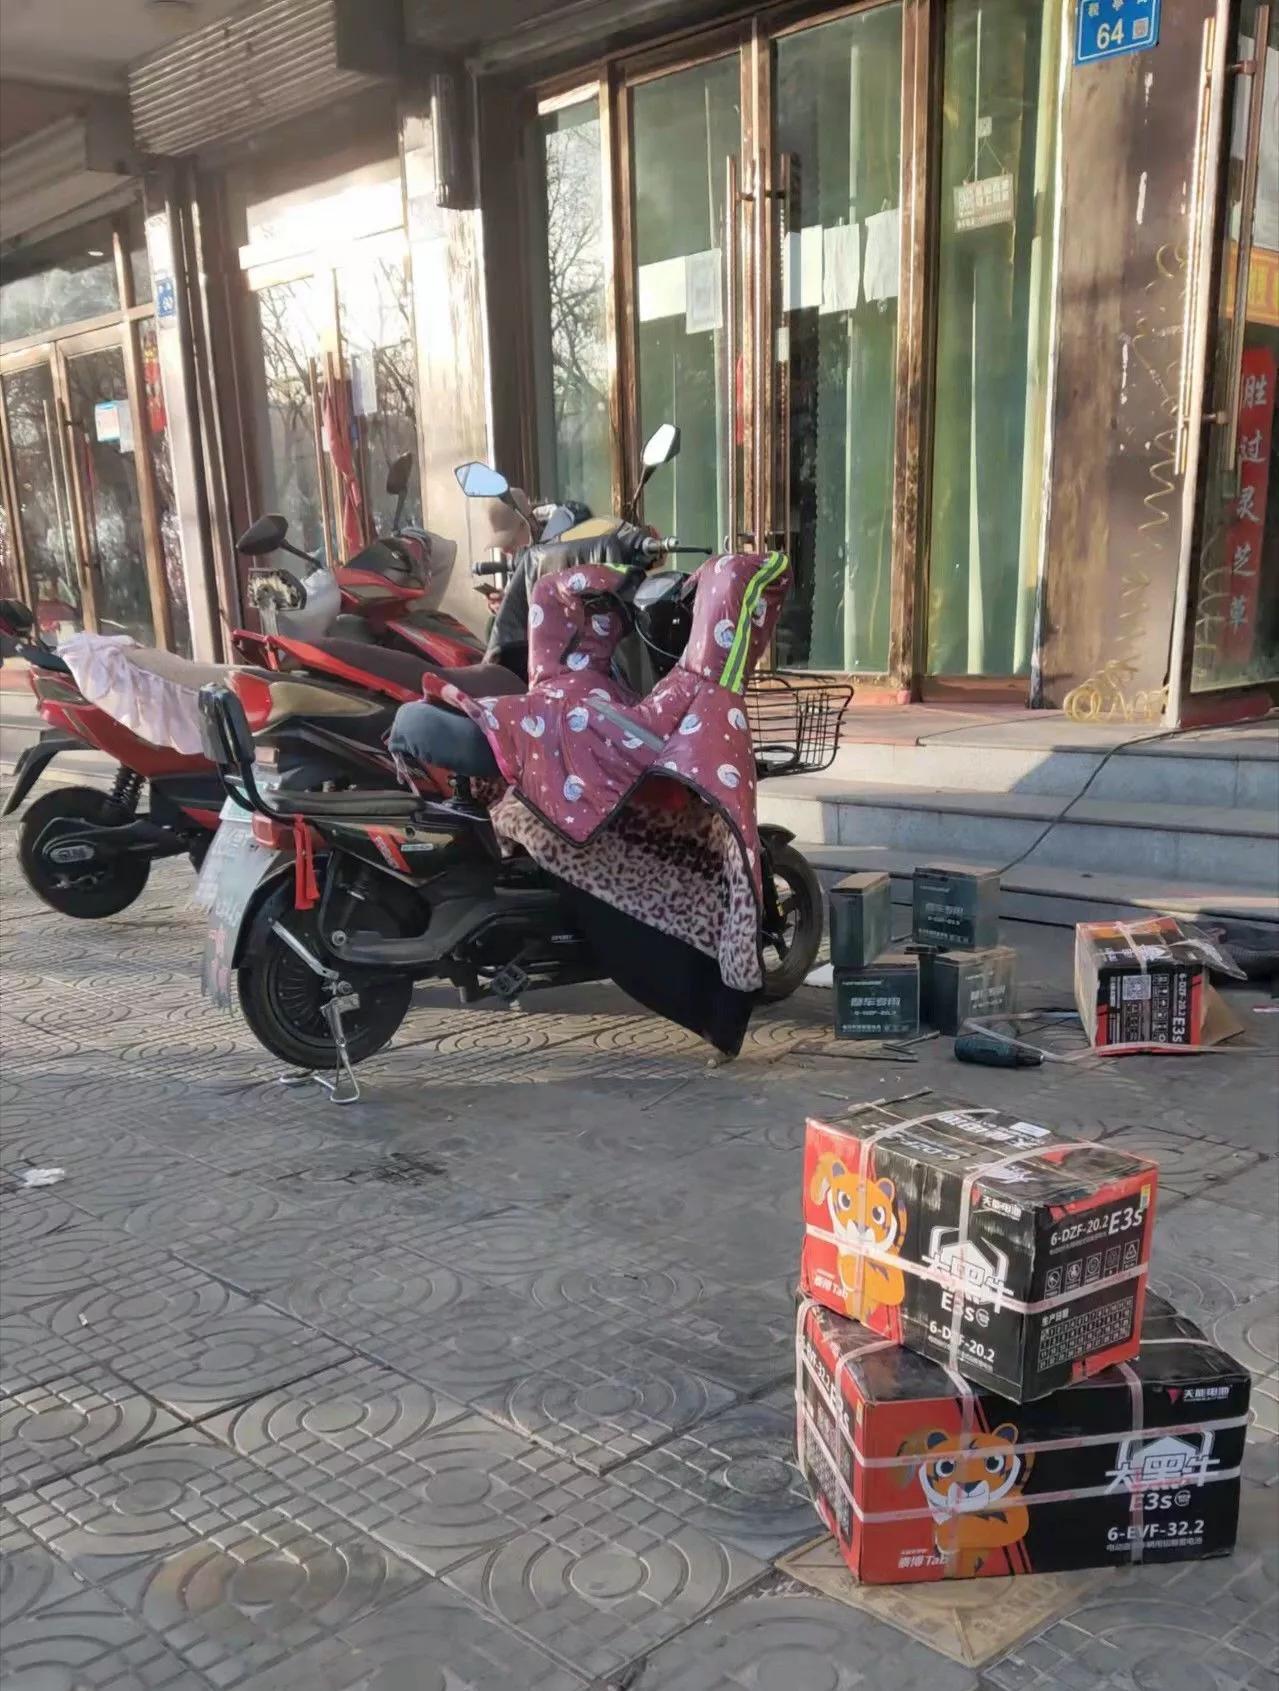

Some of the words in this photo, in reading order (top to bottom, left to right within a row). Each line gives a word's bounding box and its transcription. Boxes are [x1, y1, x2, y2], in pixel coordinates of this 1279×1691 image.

[1097, 18, 1125, 49] 64
[1228, 374, 1268, 635] 胜过灵芝草
[1050, 1215, 1109, 1247] 6-DZF-20.2
[1108, 1206, 1143, 1236] E3s
[928, 1320, 996, 1364] 6-DF-20.2
[1129, 1492, 1173, 1512] E3s
[1107, 1519, 1205, 1542] 6-EVF-32.2
